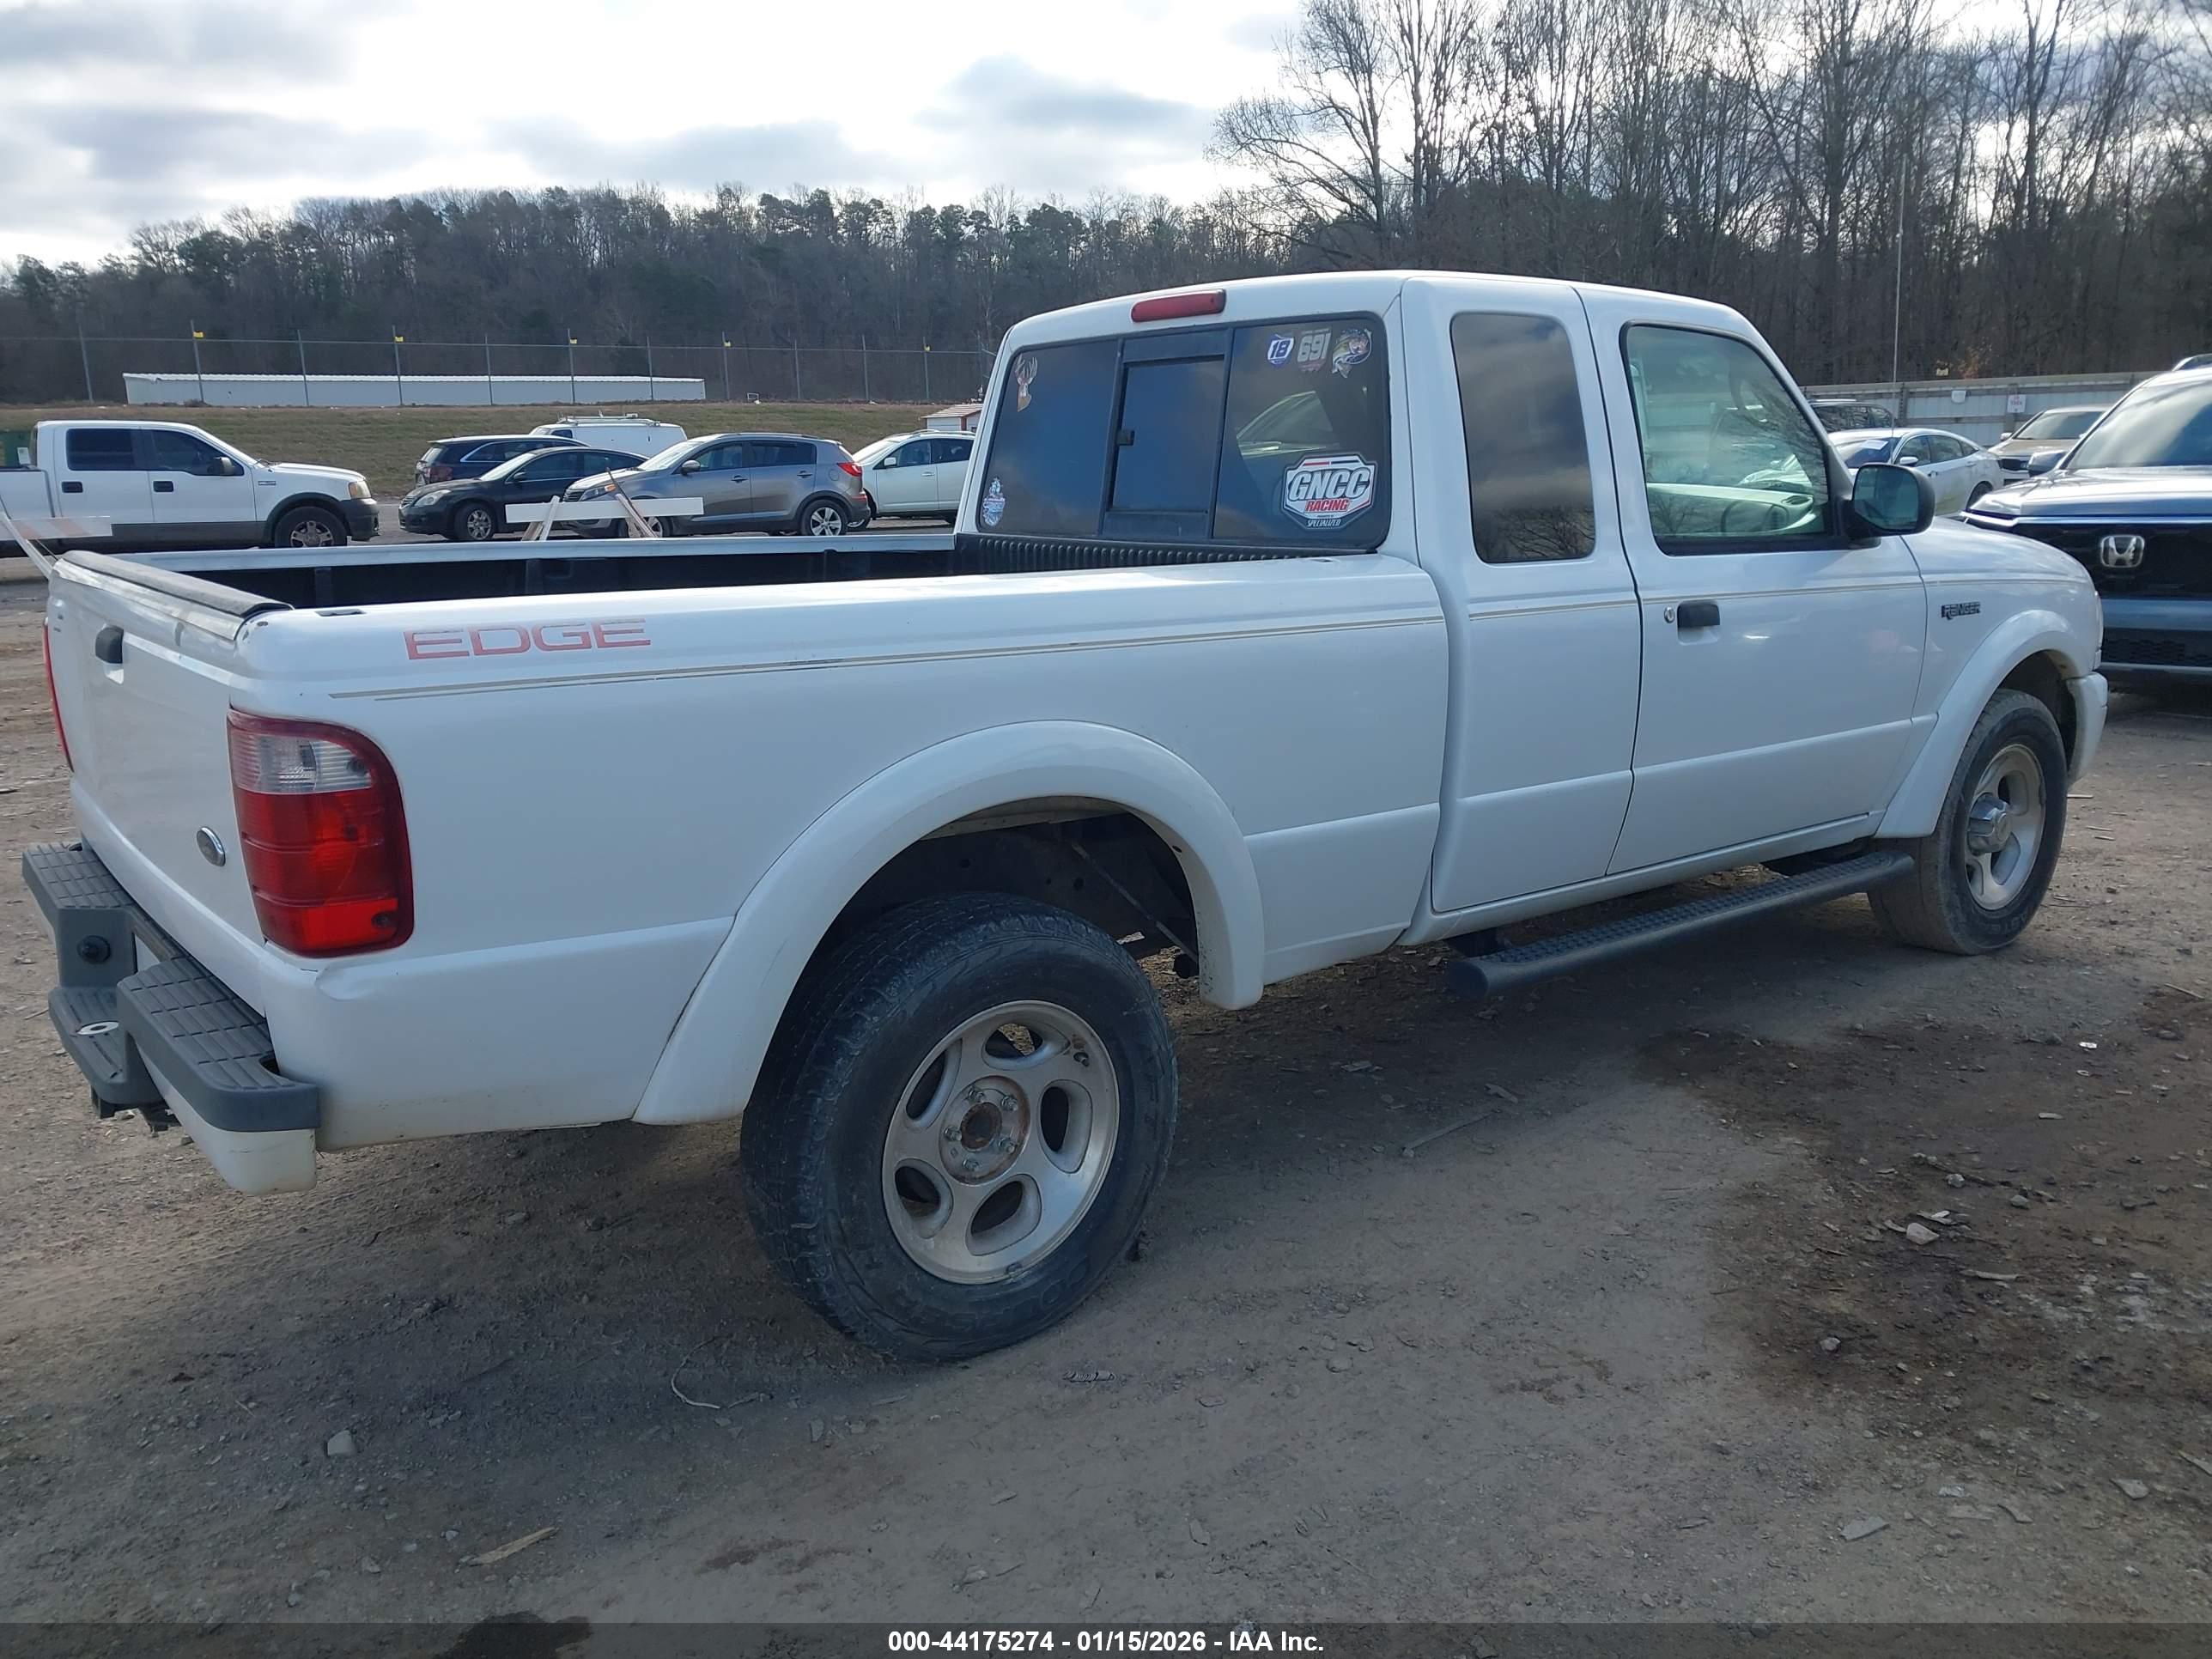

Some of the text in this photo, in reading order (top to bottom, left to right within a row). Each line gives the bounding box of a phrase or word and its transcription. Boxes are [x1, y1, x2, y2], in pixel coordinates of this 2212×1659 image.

[1297, 333, 1331, 362] 691
[1289, 468, 1370, 501] GNCC
[1305, 500, 1349, 512] RACING
[404, 618, 651, 659] EDGE
